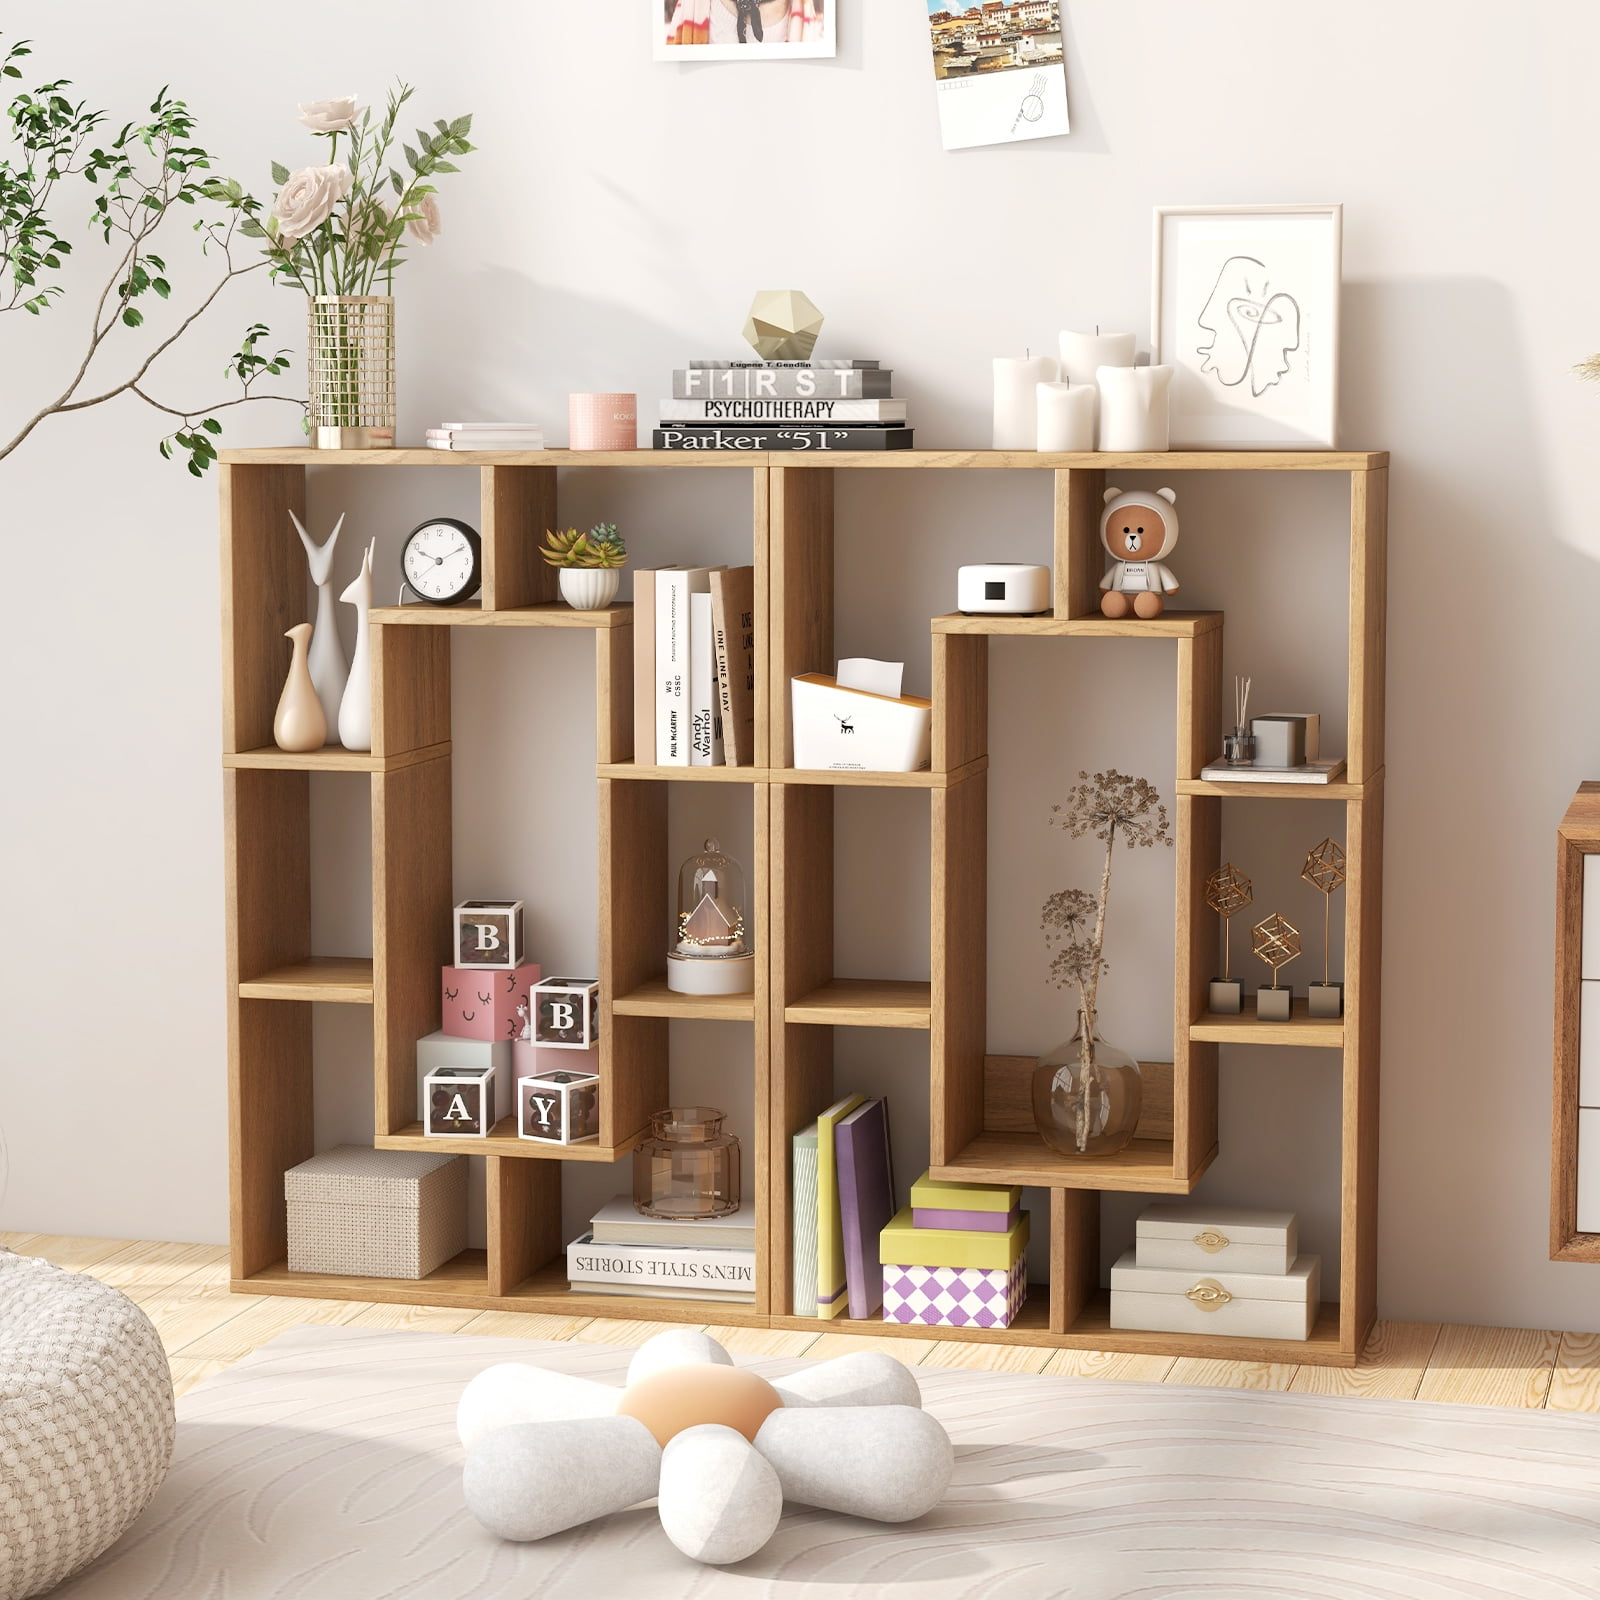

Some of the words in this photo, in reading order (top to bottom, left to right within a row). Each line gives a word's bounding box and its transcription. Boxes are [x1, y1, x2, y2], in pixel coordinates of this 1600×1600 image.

[729, 361, 764, 369] Eugene
[705, 400, 835, 419] PSYCHOTHERAPY
[661, 430, 767, 450] Parker
[436, 528, 444, 537] 12
[717, 630, 725, 651] ONE
[719, 655, 727, 678] LINE
[665, 680, 672, 694] WS
[722, 692, 730, 712] DAY
[692, 714, 704, 751] Andy
[701, 708, 711, 758] Warhol
[474, 924, 500, 951] B
[549, 1002, 574, 1030] B
[443, 1093, 473, 1121] A
[532, 1096, 556, 1125] Y
[575, 1256, 644, 1275] STORIES
[647, 1260, 698, 1278] STYLE
[702, 1263, 752, 1281] MEN'S
